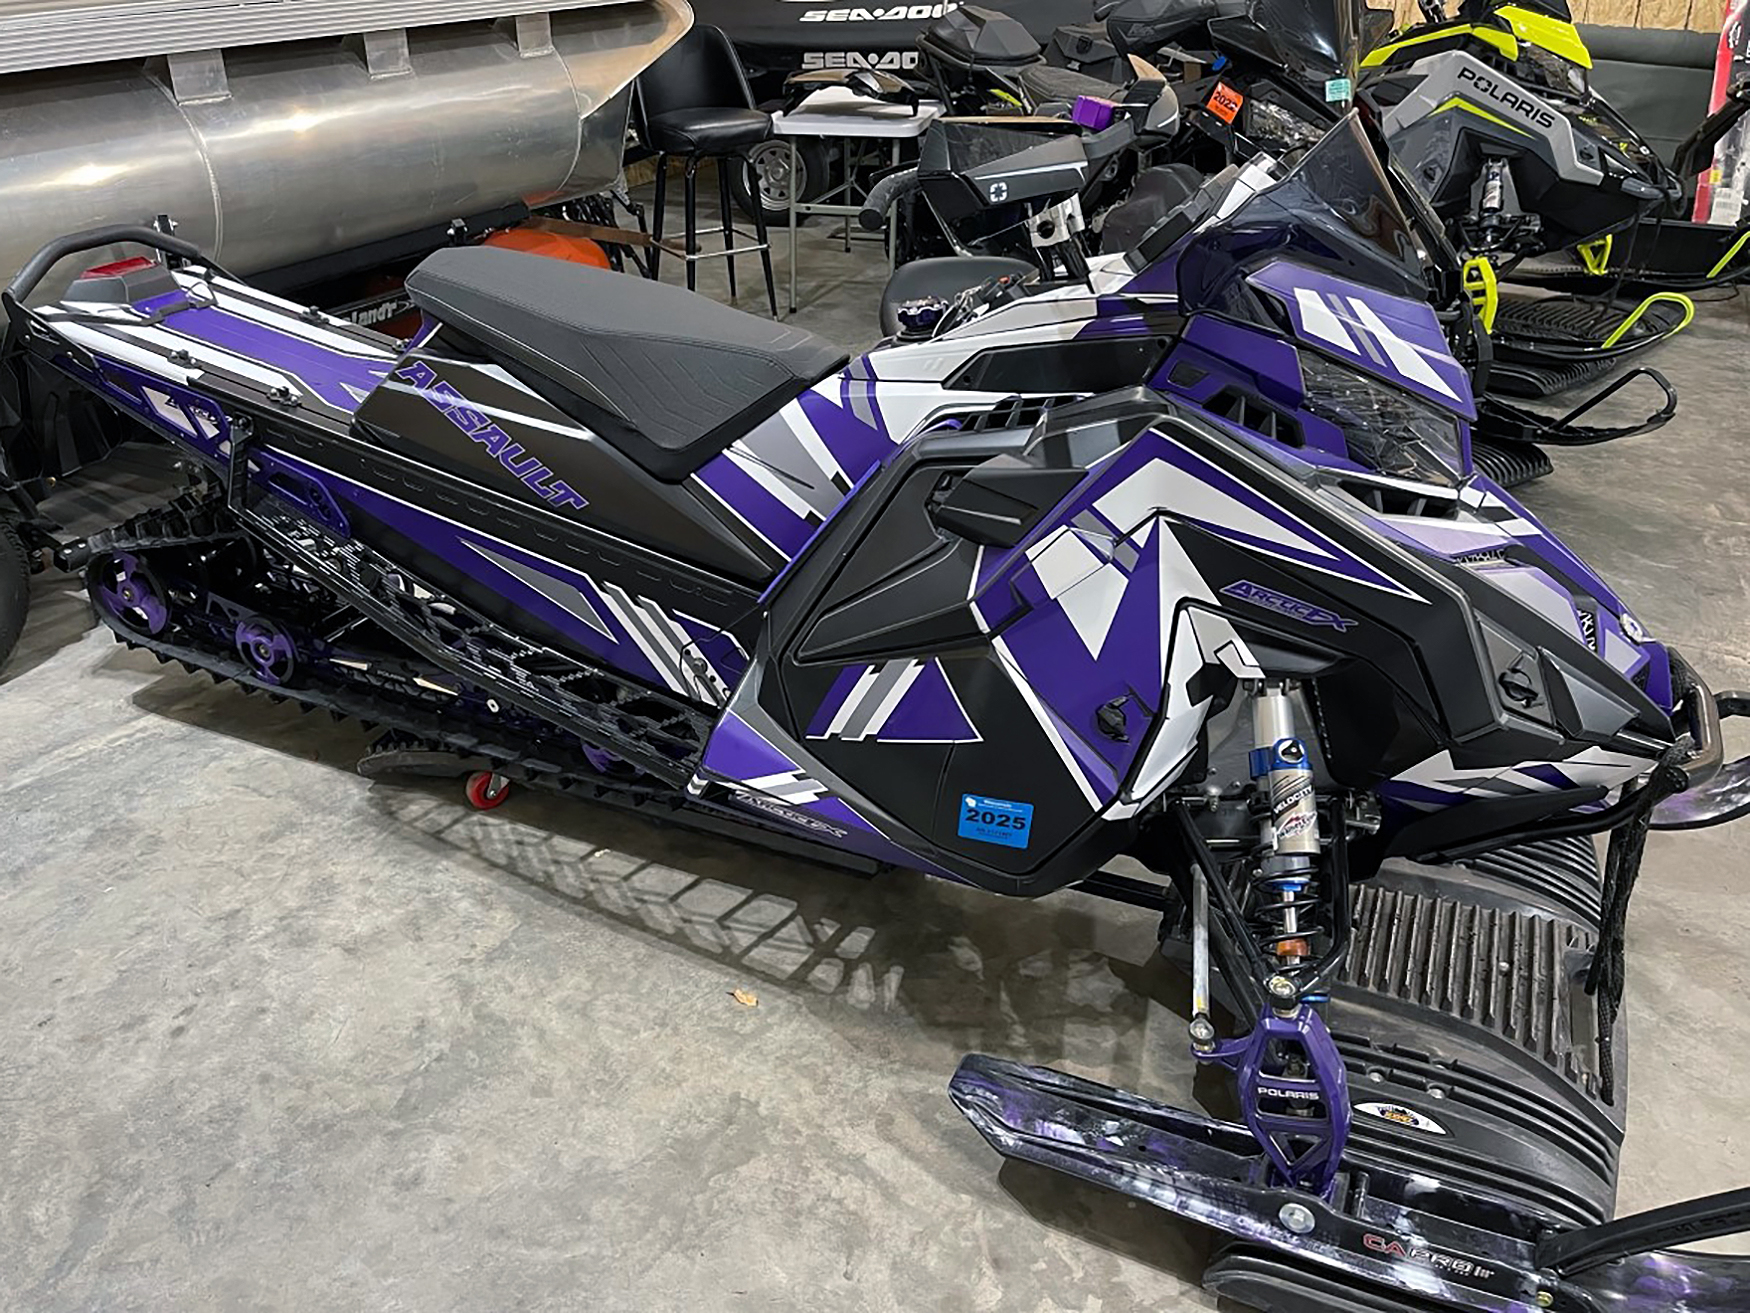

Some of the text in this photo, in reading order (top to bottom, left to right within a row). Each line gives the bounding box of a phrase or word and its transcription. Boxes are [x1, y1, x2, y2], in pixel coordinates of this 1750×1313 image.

[1457, 66, 1556, 129] POLARIS
[394, 360, 590, 511] ASSAULT
[1273, 784, 1313, 814] VELOCITY
[965, 808, 1026, 831] 2025
[1257, 1086, 1320, 1100] POLARIS
